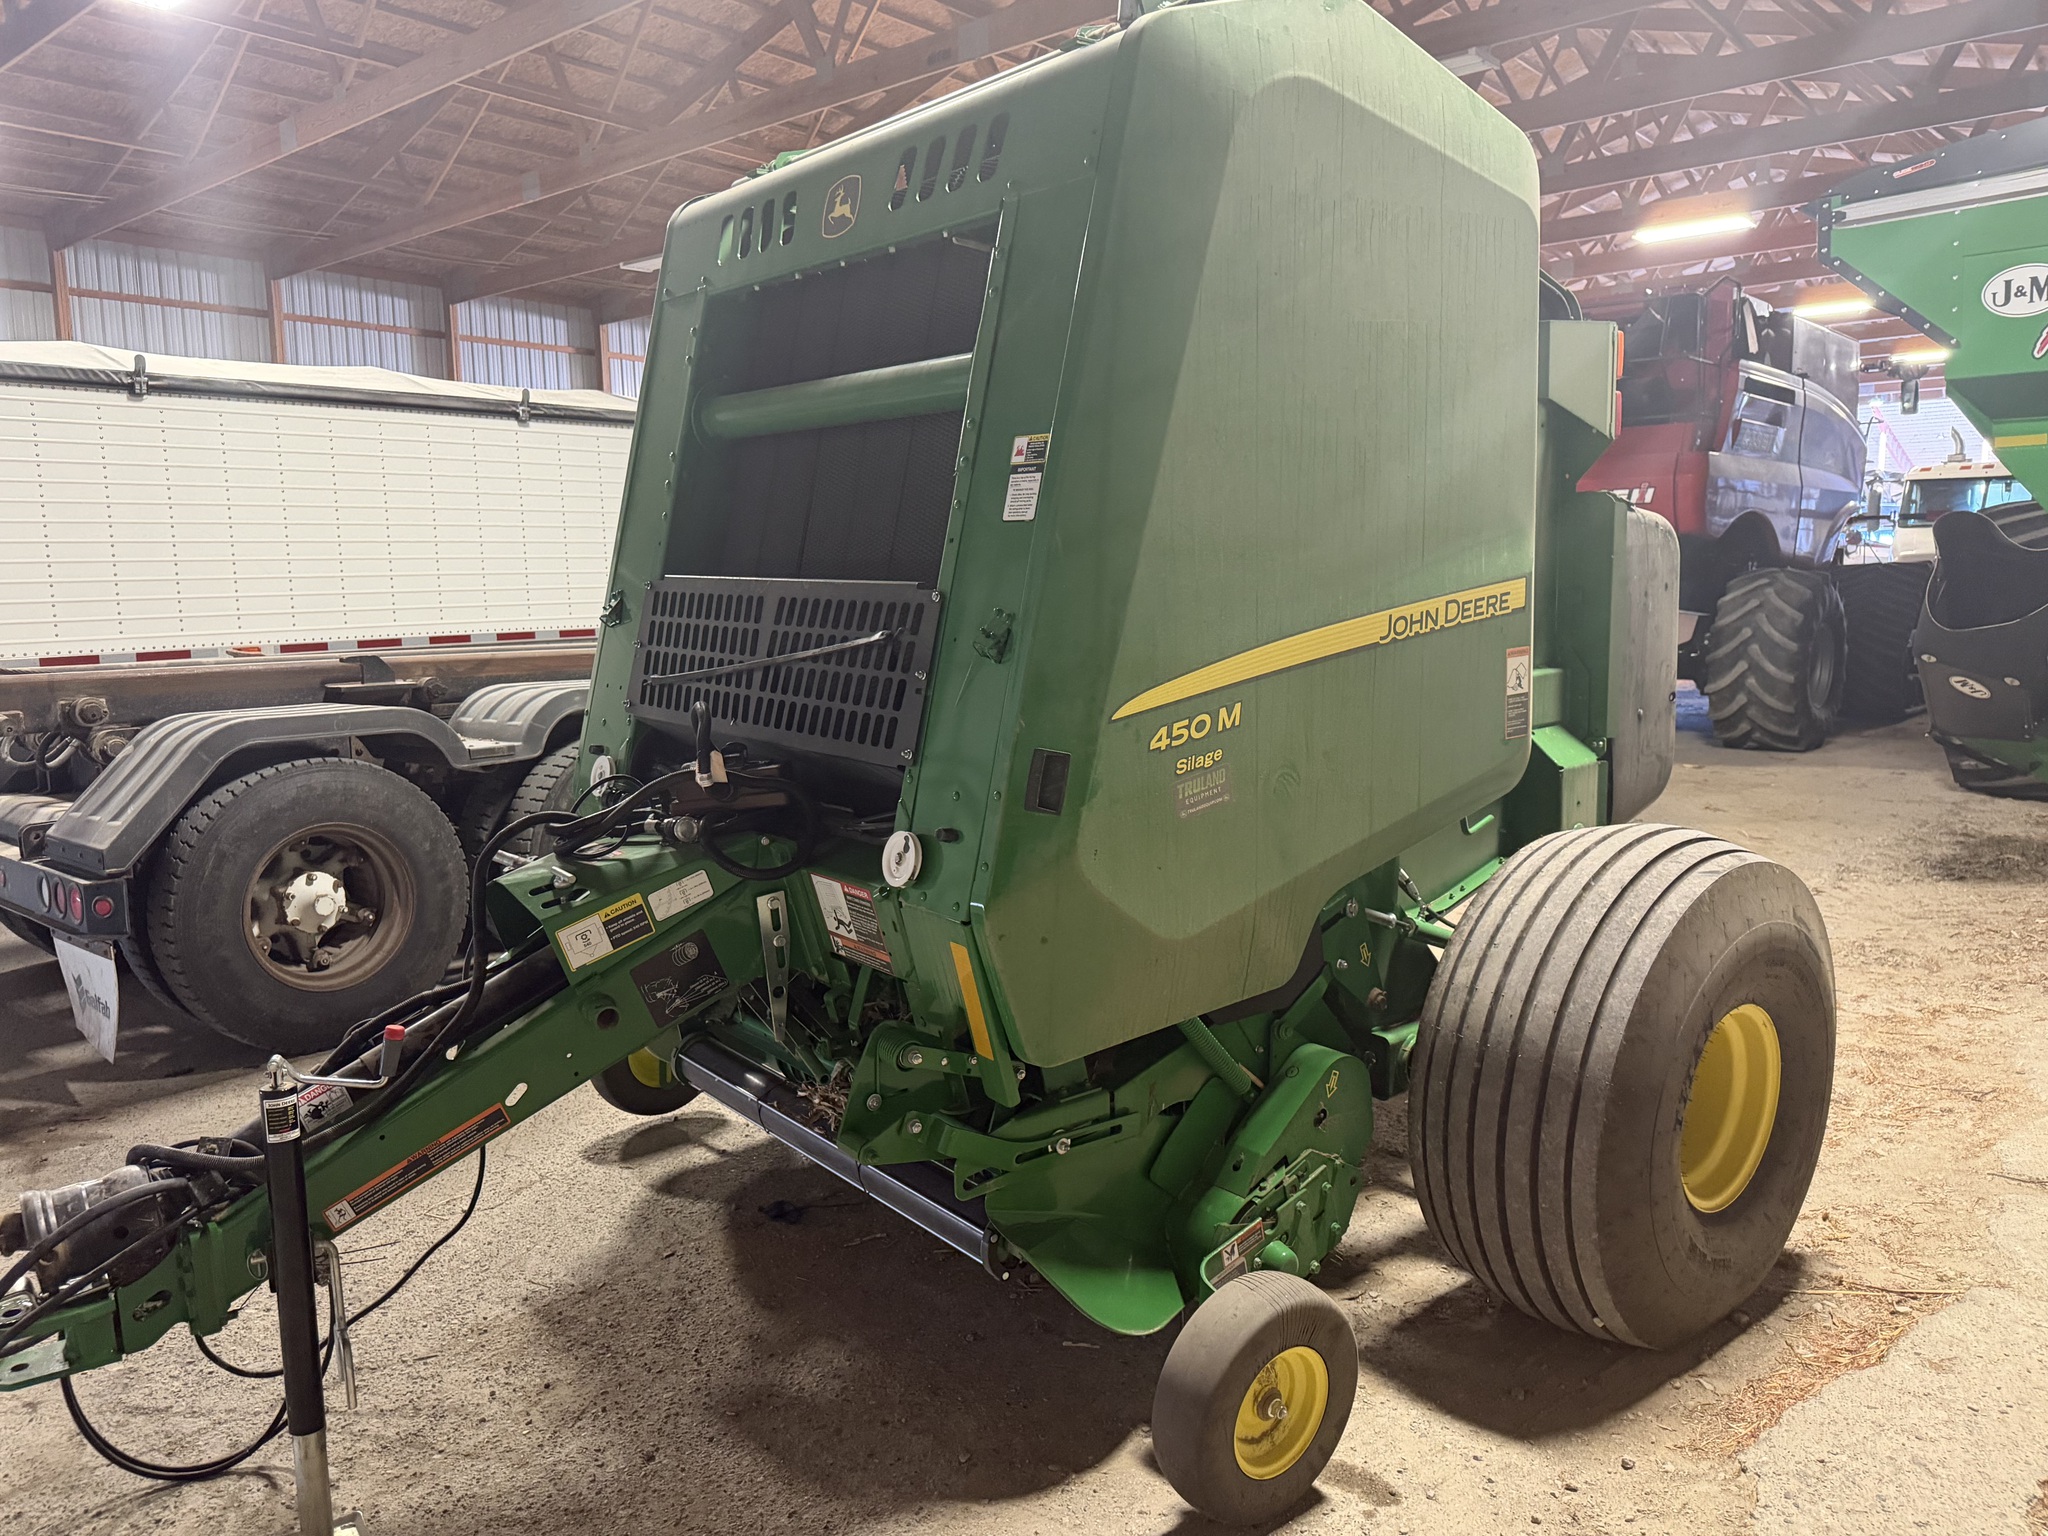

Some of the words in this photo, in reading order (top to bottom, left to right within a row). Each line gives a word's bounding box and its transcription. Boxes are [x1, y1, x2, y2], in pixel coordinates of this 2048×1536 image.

[1379, 607, 1439, 641] JOHN
[1444, 591, 1511, 625] DEERE
[1149, 713, 1212, 751] 450
[1217, 702, 1242, 732] M
[1176, 748, 1223, 775] Silage
[1176, 768, 1226, 799] TRULAND
[1185, 787, 1222, 805] EQUIPMENT
[610, 899, 637, 915] CAUTION
[411, 1139, 442, 1161] WARNING
